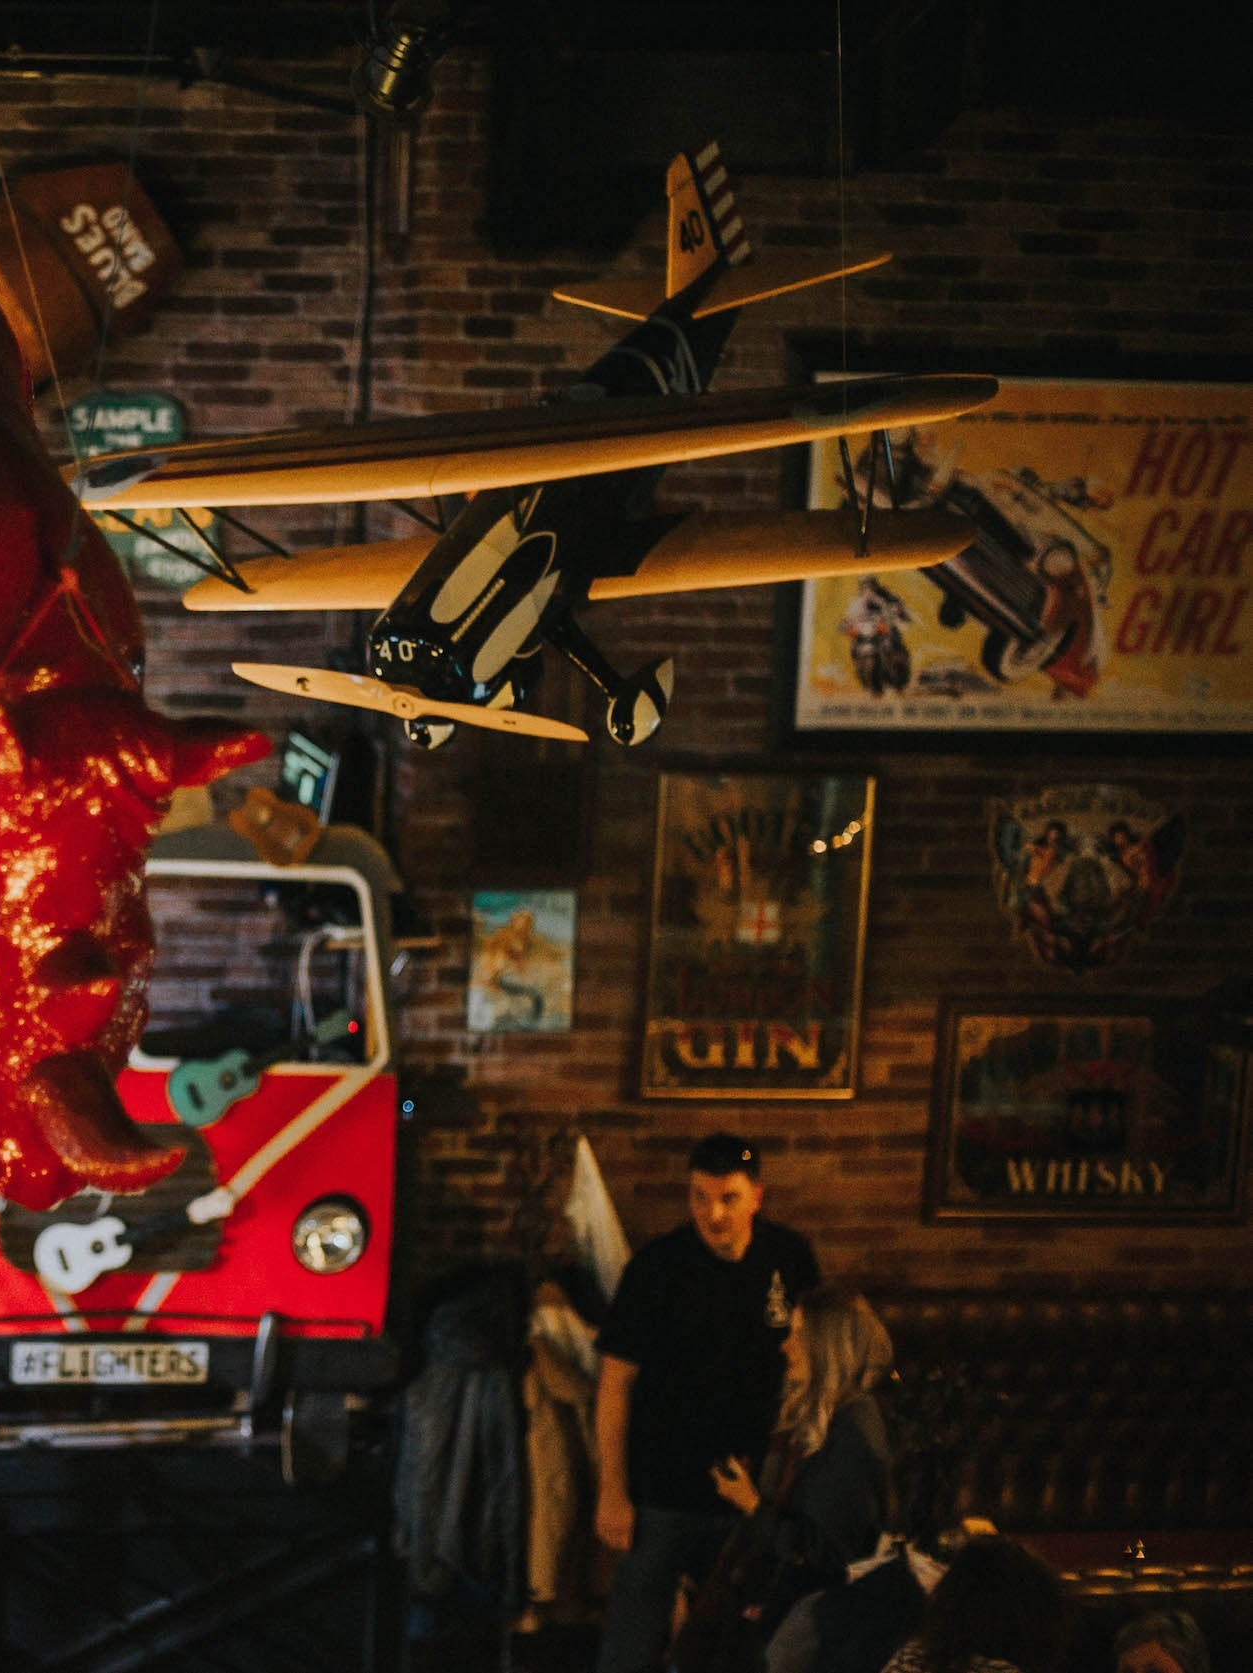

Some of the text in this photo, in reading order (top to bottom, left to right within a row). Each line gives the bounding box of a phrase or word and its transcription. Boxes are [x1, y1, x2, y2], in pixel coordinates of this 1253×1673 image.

[72, 406, 173, 432] SAMPLE
[1124, 429, 1252, 498] HOT
[1134, 506, 1253, 576] CAR
[1116, 586, 1249, 656] GIRL
[675, 1021, 822, 1070] GIN
[1005, 1157, 1171, 1195] WHISKY
